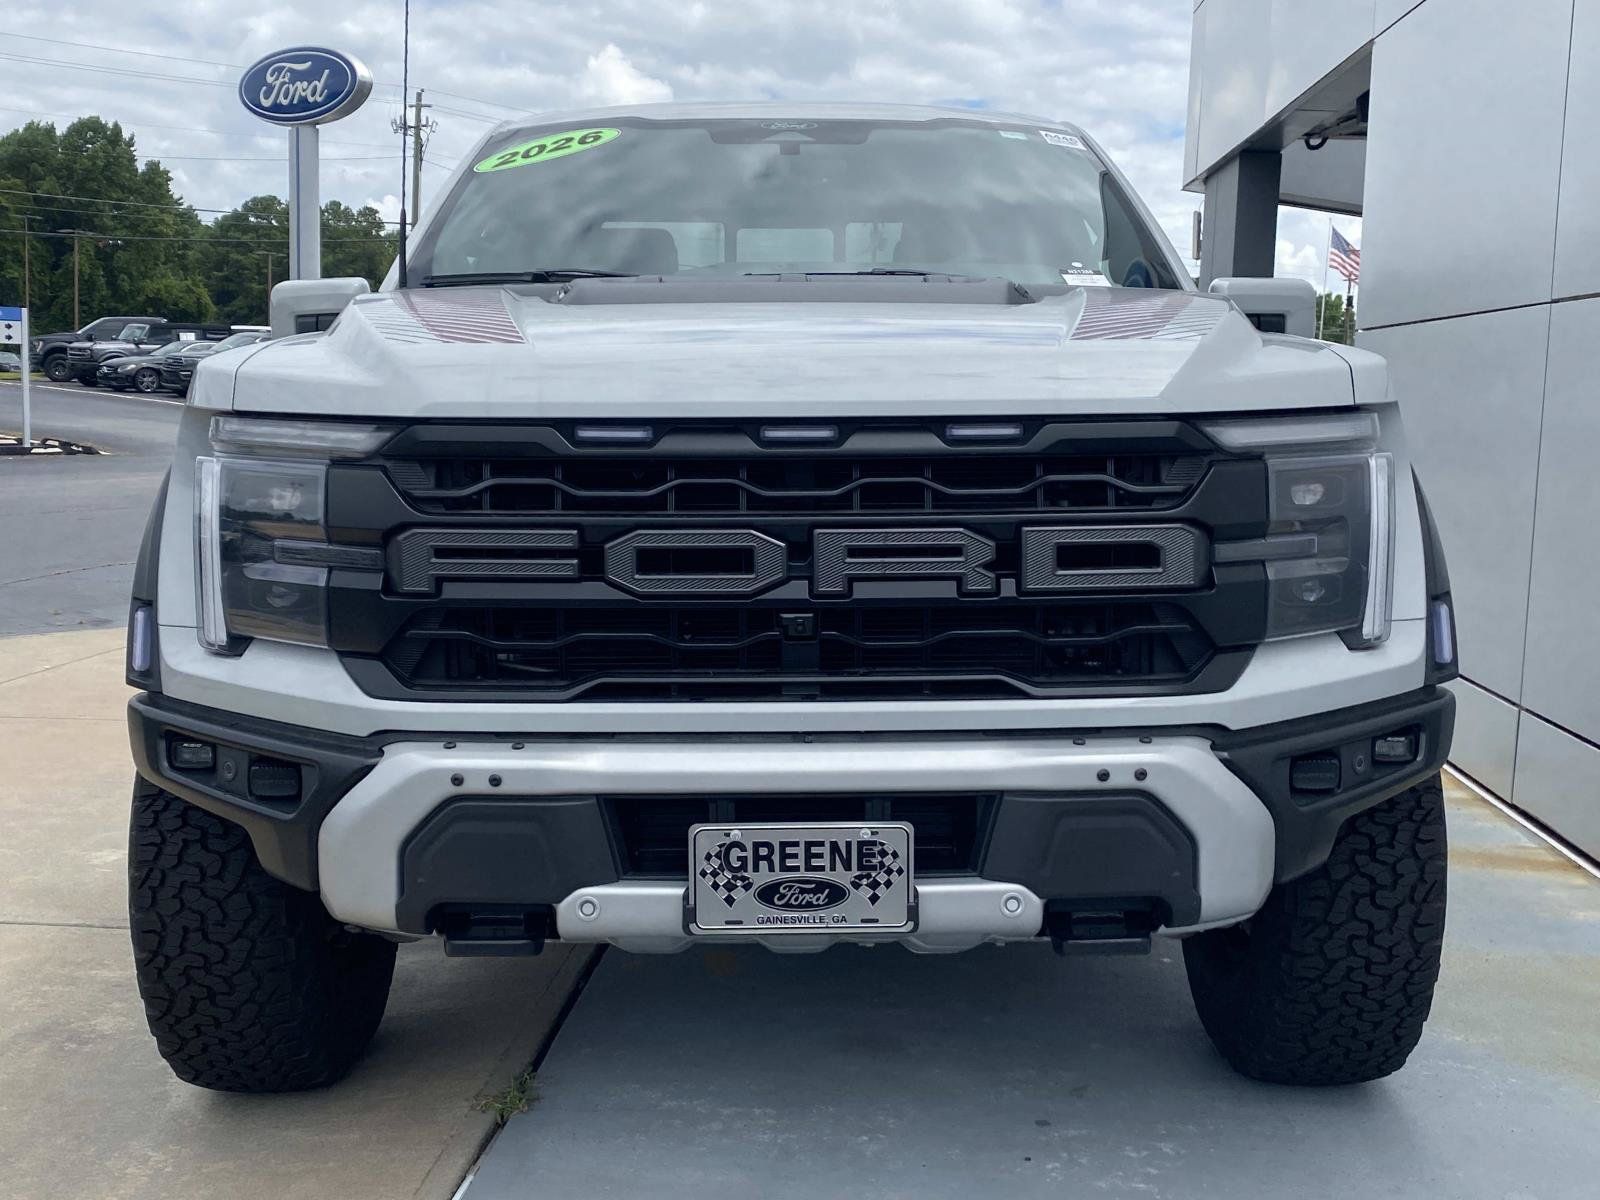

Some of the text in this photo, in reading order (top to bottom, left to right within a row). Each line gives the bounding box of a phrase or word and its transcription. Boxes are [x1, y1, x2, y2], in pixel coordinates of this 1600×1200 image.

[260, 61, 329, 107] Ford
[492, 131, 603, 168] 2026
[391, 524, 1208, 594] FORD
[722, 840, 880, 873] GREENE
[774, 882, 828, 906] Ford
[756, 914, 848, 926] GAINESVILLE, GA
